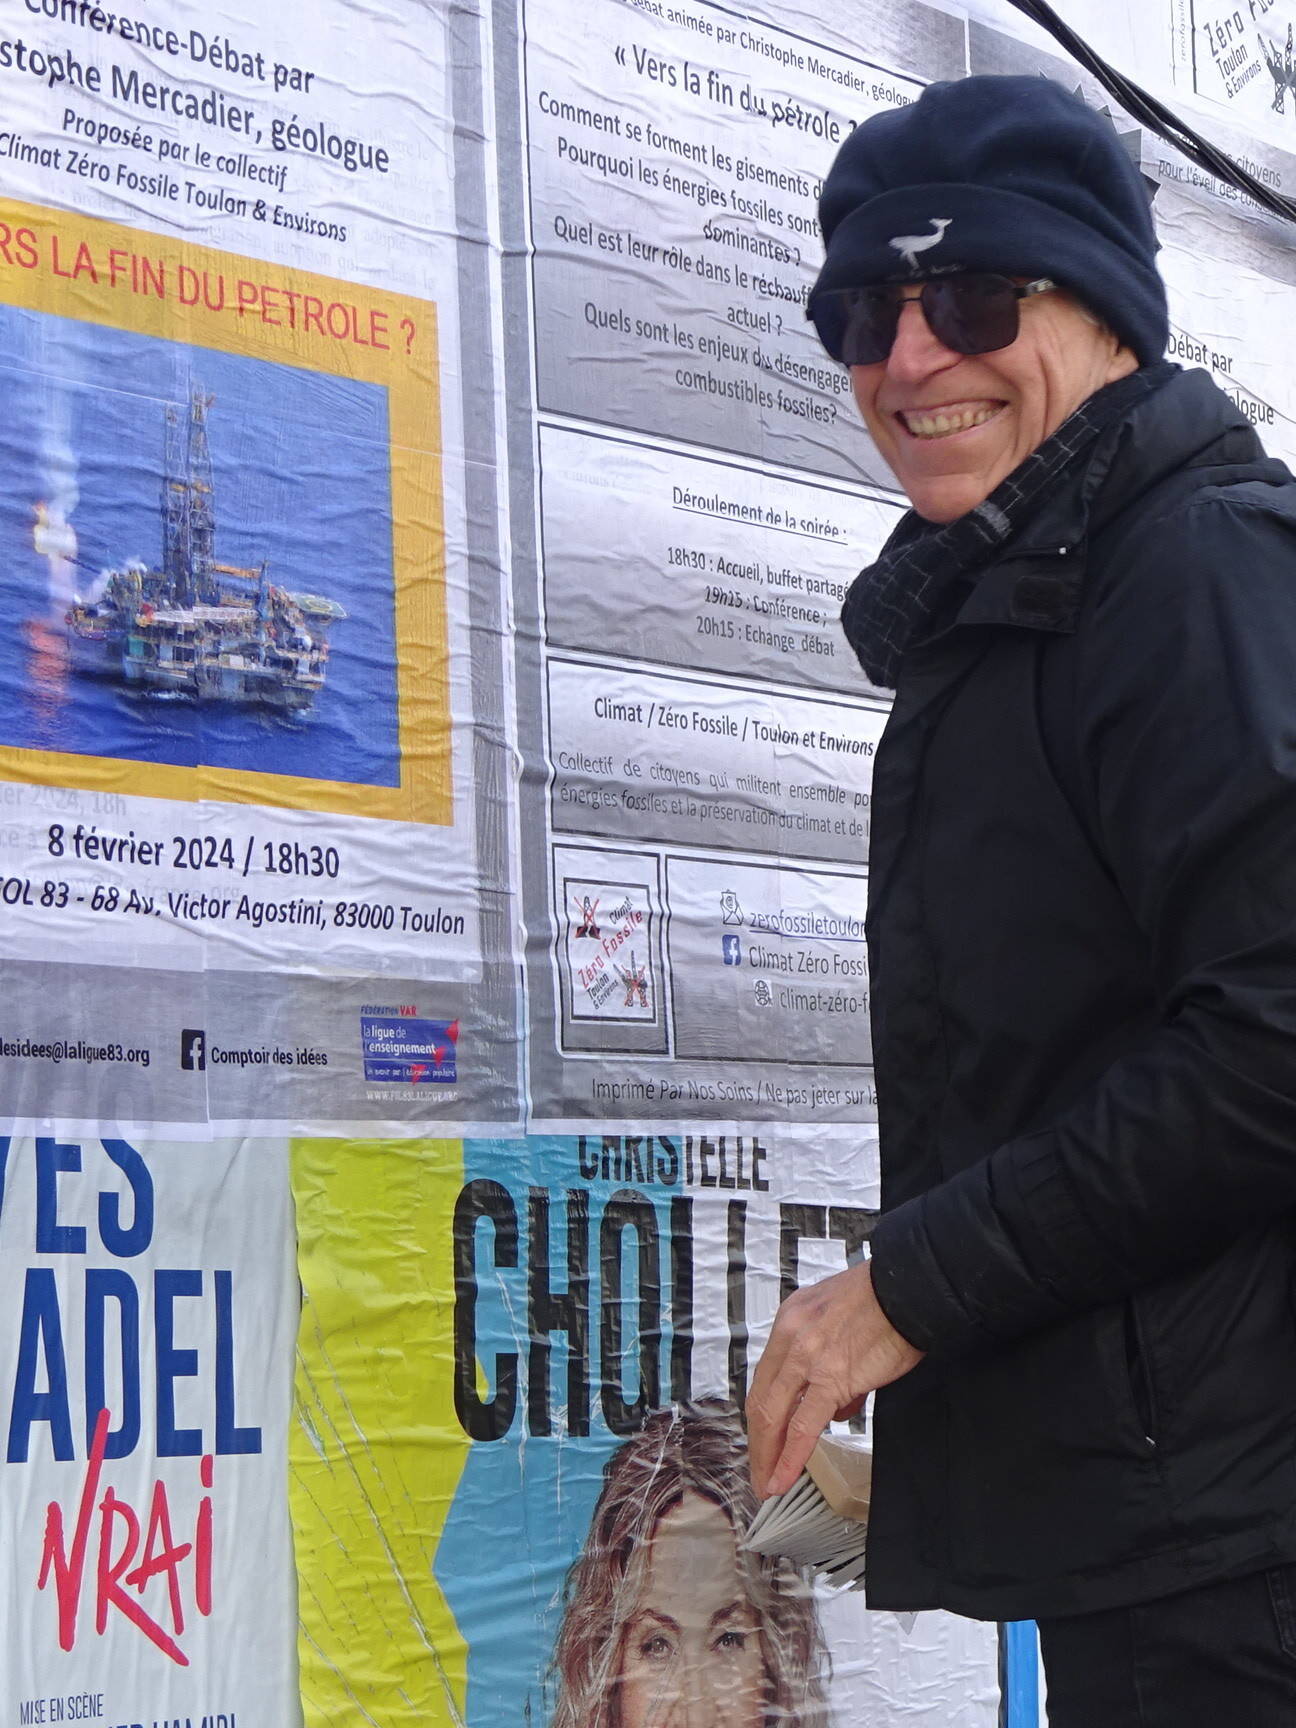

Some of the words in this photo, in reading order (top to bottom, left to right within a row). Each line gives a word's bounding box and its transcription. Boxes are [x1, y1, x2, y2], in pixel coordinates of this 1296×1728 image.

[667, 9, 713, 37] animée
[717, 26, 736, 44] par
[740, 31, 804, 69] Christophe
[1204, 10, 1244, 57] Zéro
[274, 62, 315, 93] par
[1216, 44, 1248, 79] Toulon
[1232, 60, 1262, 93] Environs
[0, 39, 101, 92] stophe
[112, 65, 262, 144] Mercadier,
[272, 115, 390, 173] géologue
[632, 44, 677, 86] Vers
[684, 61, 700, 95] la
[707, 71, 732, 107] fin
[740, 84, 767, 116] du
[772, 97, 840, 143] pétrole
[63, 108, 153, 152] Proposée
[159, 138, 189, 167] par
[195, 143, 212, 168] le
[217, 154, 288, 193] collectif
[539, 92, 621, 136] Comment
[626, 124, 642, 142] se
[647, 129, 708, 167] forment
[711, 152, 732, 172] les
[736, 160, 809, 199] gisements
[0, 133, 61, 170] Climat
[66, 150, 110, 182] Zéro
[117, 164, 179, 201] Fossile
[184, 181, 247, 217] Toulon
[252, 200, 267, 222] &
[273, 207, 347, 242] Environs
[558, 136, 634, 181] Pourquoi
[639, 159, 659, 187] les
[663, 169, 727, 208] énergies
[731, 190, 783, 227] fossiles
[1159, 160, 1183, 179] pour
[1220, 183, 1237, 200] des
[1237, 155, 1281, 188] citoyens
[555, 215, 593, 246] Quel
[598, 230, 622, 255] est
[628, 234, 658, 263] leur
[663, 245, 691, 272] rôle
[696, 253, 730, 283] dans
[735, 264, 748, 289] le
[703, 220, 790, 264] dominantes
[52, 236, 97, 284] LA
[109, 249, 166, 300] FIN
[179, 266, 225, 312] DU
[238, 280, 390, 350] PETROLE
[727, 305, 772, 334] actuel
[585, 302, 631, 334] Quels
[635, 321, 669, 344] sont
[673, 323, 694, 350] les
[698, 336, 748, 367] enjeux
[752, 347, 773, 371] du
[774, 353, 853, 395] désengage
[1212, 352, 1233, 373] par
[675, 366, 773, 409] combustibles
[673, 486, 763, 524] Déroulement
[766, 507, 782, 526] de
[785, 510, 797, 530] la
[800, 519, 840, 537] soirée
[667, 547, 706, 571] 18h30
[717, 557, 764, 585] Accueil,
[767, 570, 803, 590] buffet
[705, 585, 743, 609] 19h15
[753, 595, 820, 623] Conférence
[696, 615, 735, 640] 20h15
[745, 624, 796, 651] Echange
[801, 629, 835, 657] débat
[594, 697, 643, 724] Climat
[658, 706, 688, 730] Zéro
[692, 712, 738, 736] Fossile
[752, 720, 799, 745] Toulon
[803, 732, 816, 748] et
[819, 731, 874, 757] Environs
[558, 751, 613, 775] Collectif
[623, 757, 642, 777] de
[650, 761, 701, 788] citoyens
[709, 770, 729, 791] qui
[736, 772, 782, 796] militent
[790, 778, 846, 804] ensemble
[560, 782, 618, 810] énergies
[621, 789, 668, 814] fossiles
[671, 798, 684, 815] et
[687, 799, 697, 817] la
[700, 802, 776, 827] préservation
[778, 808, 793, 828] du
[796, 812, 831, 834] climat
[834, 818, 846, 836] et
[849, 817, 863, 837] de
[48, 824, 64, 857] 8
[73, 824, 164, 867] février
[173, 836, 235, 870] 2024
[263, 842, 340, 878] 18h30
[0, 877, 34, 906] OL
[40, 880, 69, 908] 83
[91, 885, 120, 912] 68
[124, 888, 161, 918] Av.
[167, 892, 231, 921] Victor
[236, 896, 327, 931] Agostini,
[333, 903, 394, 931] 83000
[401, 906, 465, 935] Toulon
[578, 955, 604, 988] Zéro
[602, 911, 643, 958] Fossile
[749, 946, 794, 972] Climat
[797, 951, 829, 974] Zéro
[587, 973, 609, 1000] Toulon
[363, 1025, 371, 1037] la
[371, 1025, 395, 1040] ligue
[395, 1027, 407, 1038] de
[400, 1005, 417, 1017] VAR
[211, 1046, 270, 1068] Comptoir
[272, 1047, 293, 1065] des
[296, 1048, 328, 1065] idées
[592, 1079, 654, 1102] Imprimé
[660, 1079, 682, 1099] Par
[688, 1080, 714, 1100] Nos
[719, 1080, 752, 1101] Soins
[766, 1083, 782, 1102] Ne
[786, 1086, 808, 1106] pas
[811, 1084, 840, 1109] jeter
[845, 1089, 864, 1105] sur
[7, 1268, 262, 1463] ADEL
[20, 1699, 46, 1726] MISE
[50, 1697, 64, 1722] EN
[67, 1691, 104, 1720] SCÈNE
